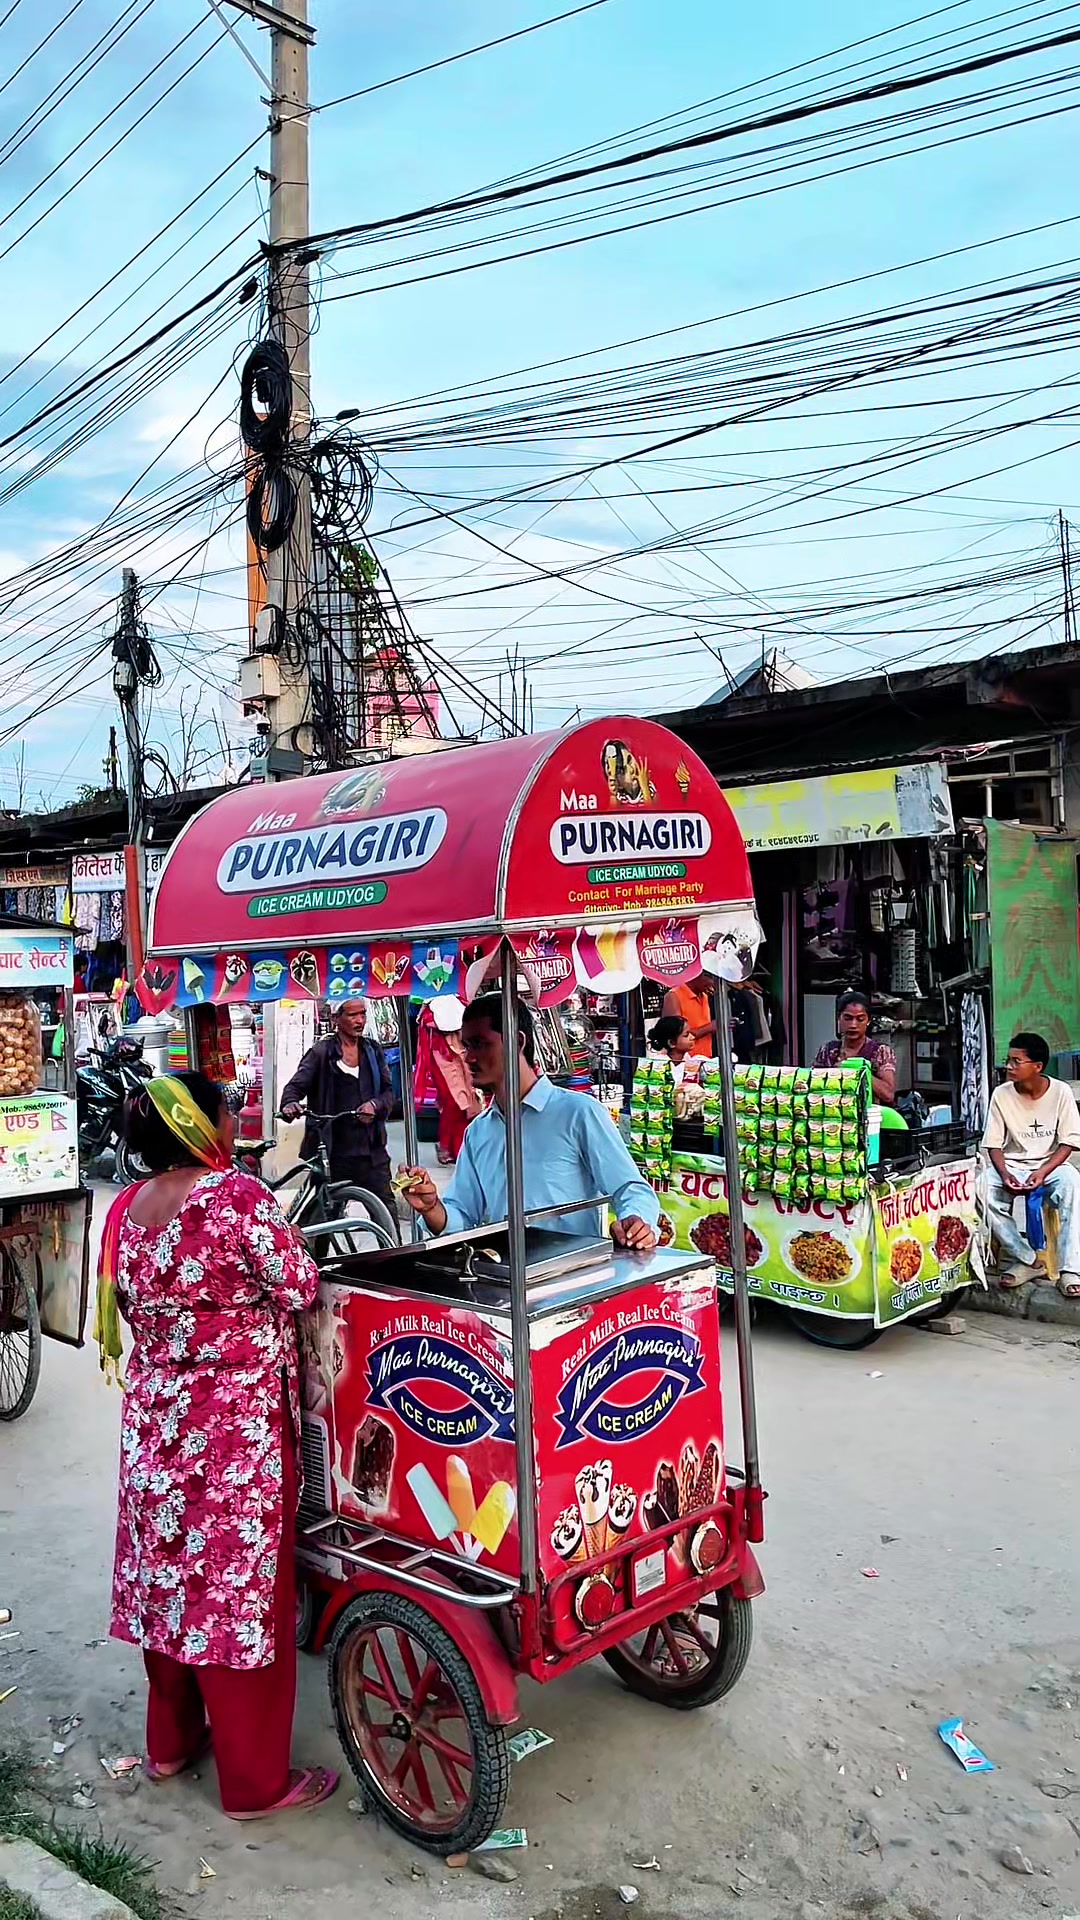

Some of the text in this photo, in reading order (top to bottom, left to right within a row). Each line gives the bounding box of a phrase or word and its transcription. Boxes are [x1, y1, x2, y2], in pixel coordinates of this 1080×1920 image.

[560, 788, 598, 810] Maa
[247, 810, 297, 832] Maa
[560, 819, 703, 856] PURNAGIRI
[227, 815, 436, 882] PURNAGIRI
[568, 881, 704, 902] Contact For Marriage Party
[595, 864, 679, 882] ICE CREAM UDYOG
[257, 886, 374, 914] ICE CREAM UDYOG
[645, 945, 694, 966] PURNAGIRI
[394, 1315, 419, 1332] Milk
[421, 1315, 445, 1336] Real
[447, 1321, 465, 1343] Ice
[467, 1333, 507, 1378] Cream
[561, 1303, 696, 1381] Real Milk Real Ice Cream
[376, 1338, 512, 1414] Maa Purnagiri
[570, 1335, 694, 1421] Maa Purnagiri
[400, 1396, 477, 1436] ICE CREAM
[598, 1383, 673, 1432] ICE CREAM
